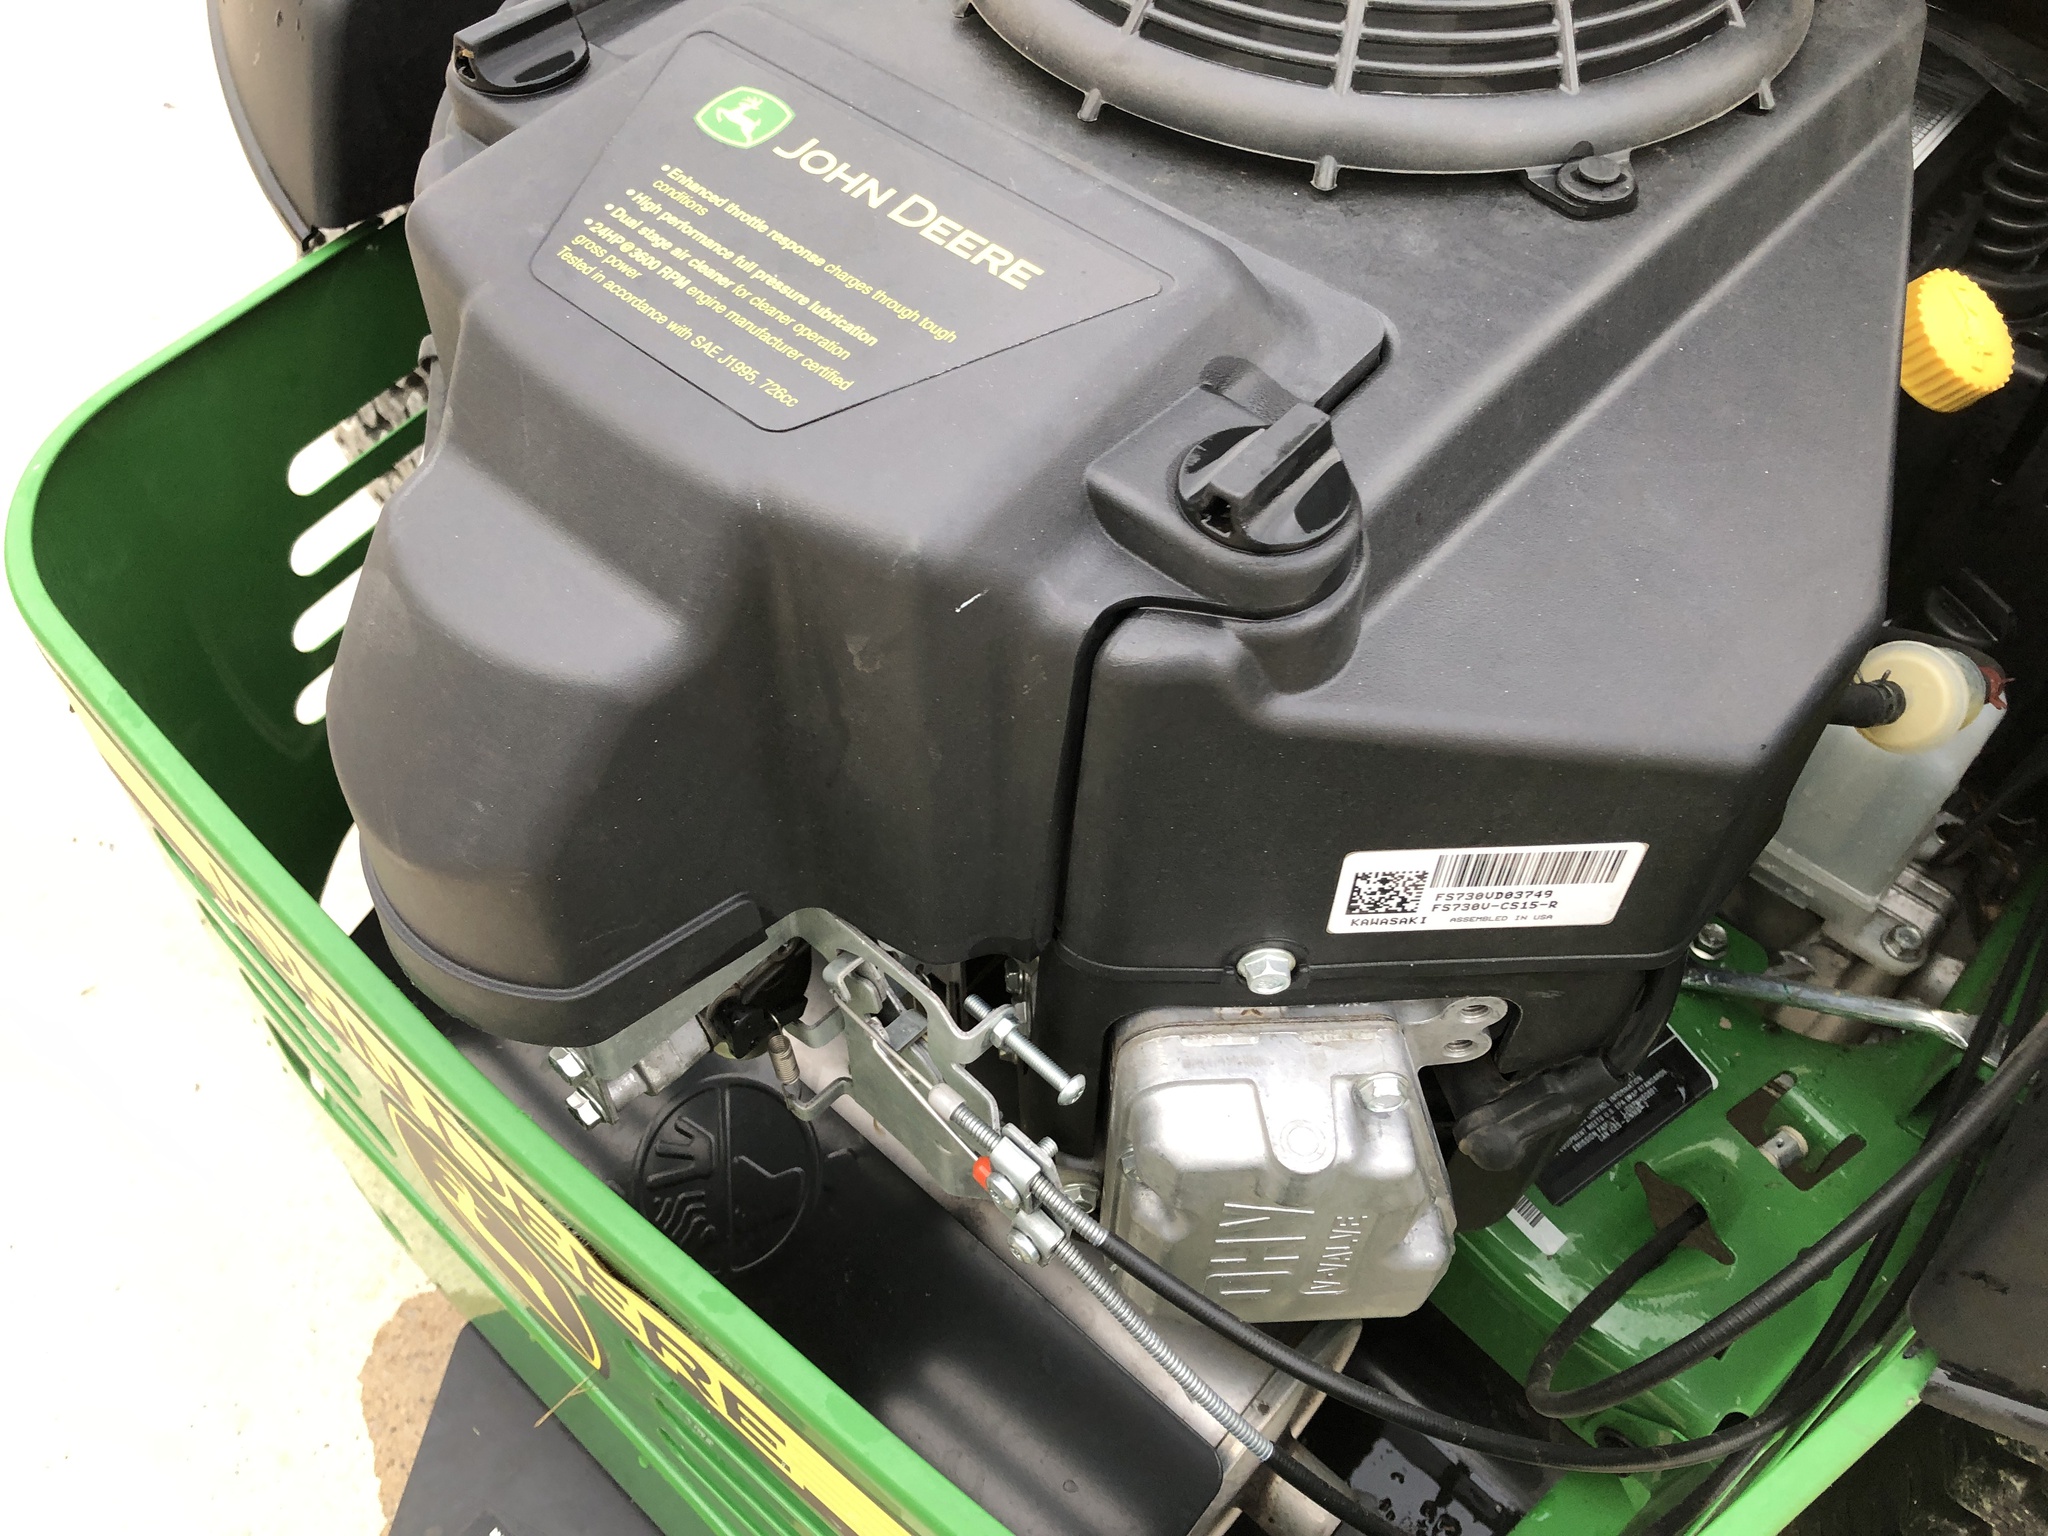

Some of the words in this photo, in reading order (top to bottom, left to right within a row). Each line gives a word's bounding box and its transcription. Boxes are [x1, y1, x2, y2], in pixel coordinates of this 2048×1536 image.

[571, 234, 608, 258] gross
[601, 254, 643, 280] power
[631, 192, 662, 215] High
[656, 212, 735, 260] performance
[732, 255, 758, 273] full
[750, 269, 810, 306] pressure
[808, 300, 878, 347] lubrication
[652, 179, 709, 217] conditions
[667, 167, 729, 207] Enhanced
[724, 202, 769, 233] throttle
[766, 229, 826, 266] response
[824, 263, 873, 295] charges
[871, 289, 921, 322] through
[918, 317, 957, 343] tough
[772, 138, 897, 209] JOHN
[887, 194, 1045, 290] DEERE
[557, 245, 597, 276] Tested
[591, 270, 606, 283] in
[602, 279, 668, 324] accordance
[666, 320, 693, 341] with
[690, 335, 724, 359] SAE
[717, 354, 760, 385] J1995,
[758, 378, 799, 408] 726cc
[589, 222, 662, 271] 24HP@3600
[656, 265, 692, 290] RPM
[686, 286, 727, 314] engine
[724, 310, 805, 361] manufacturer
[801, 357, 855, 391] certified
[610, 207, 644, 230] Dual
[638, 226, 673, 250] stage
[670, 246, 692, 261] air
[687, 258, 735, 289] cleaner
[731, 284, 752, 299] for
[749, 295, 796, 326] cleaner
[792, 323, 851, 361] operation
[1350, 916, 1427, 927] KAWASAKI
[1449, 915, 1508, 923] ASSEMBLED
[423, 1095, 793, 1474] DEERE
